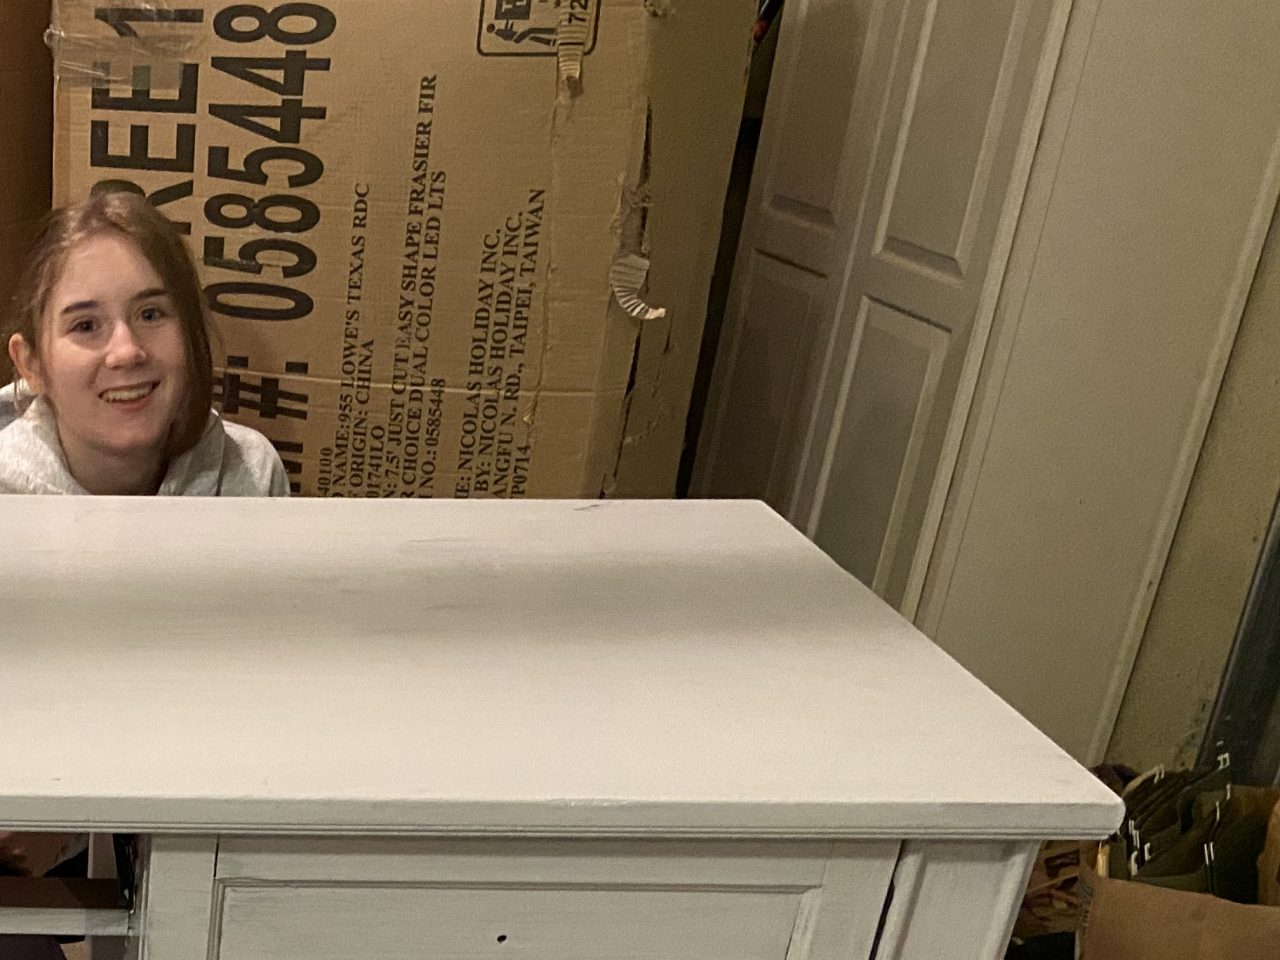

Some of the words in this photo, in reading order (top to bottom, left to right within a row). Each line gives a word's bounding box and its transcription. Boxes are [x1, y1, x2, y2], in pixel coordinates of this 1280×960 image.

[417, 75, 438, 115] FIR
[203, 2, 337, 321] 0585448
[408, 119, 433, 216] FRASIER
[427, 171, 446, 210] LTS
[352, 183, 369, 229] RDC
[422, 216, 441, 260] LED
[501, 212, 523, 256] INC.
[519, 188, 546, 277] TAIWAN
[347, 235, 366, 304] TEXAS
[401, 221, 422, 292] SHAPE
[480, 229, 501, 273] INC.
[394, 295, 414, 350] EASY
[415, 266, 436, 342] COLOR
[468, 279, 494, 376] HOLIDAY
[489, 262, 516, 360] HOLIDAY
[508, 282, 536, 358] TAIPEI,
[341, 310, 360, 388] LOWE'S
[355, 340, 374, 405] CHINA
[392, 353, 409, 396] CUT
[408, 346, 428, 403] DUAL
[424, 378, 446, 447] 0585448
[478, 366, 503, 456] NICOLAS
[503, 363, 525, 401] RD.,
[349, 411, 367, 488] ORIGIN:
[387, 399, 405, 447] JUST
[401, 409, 421, 485] CHOICE
[457, 382, 482, 470] NICOLAS
[500, 407, 517, 427] N.
[385, 450, 400, 480] 7.5'
[418, 450, 437, 490] NO.:
[474, 462, 490, 492] BY:
